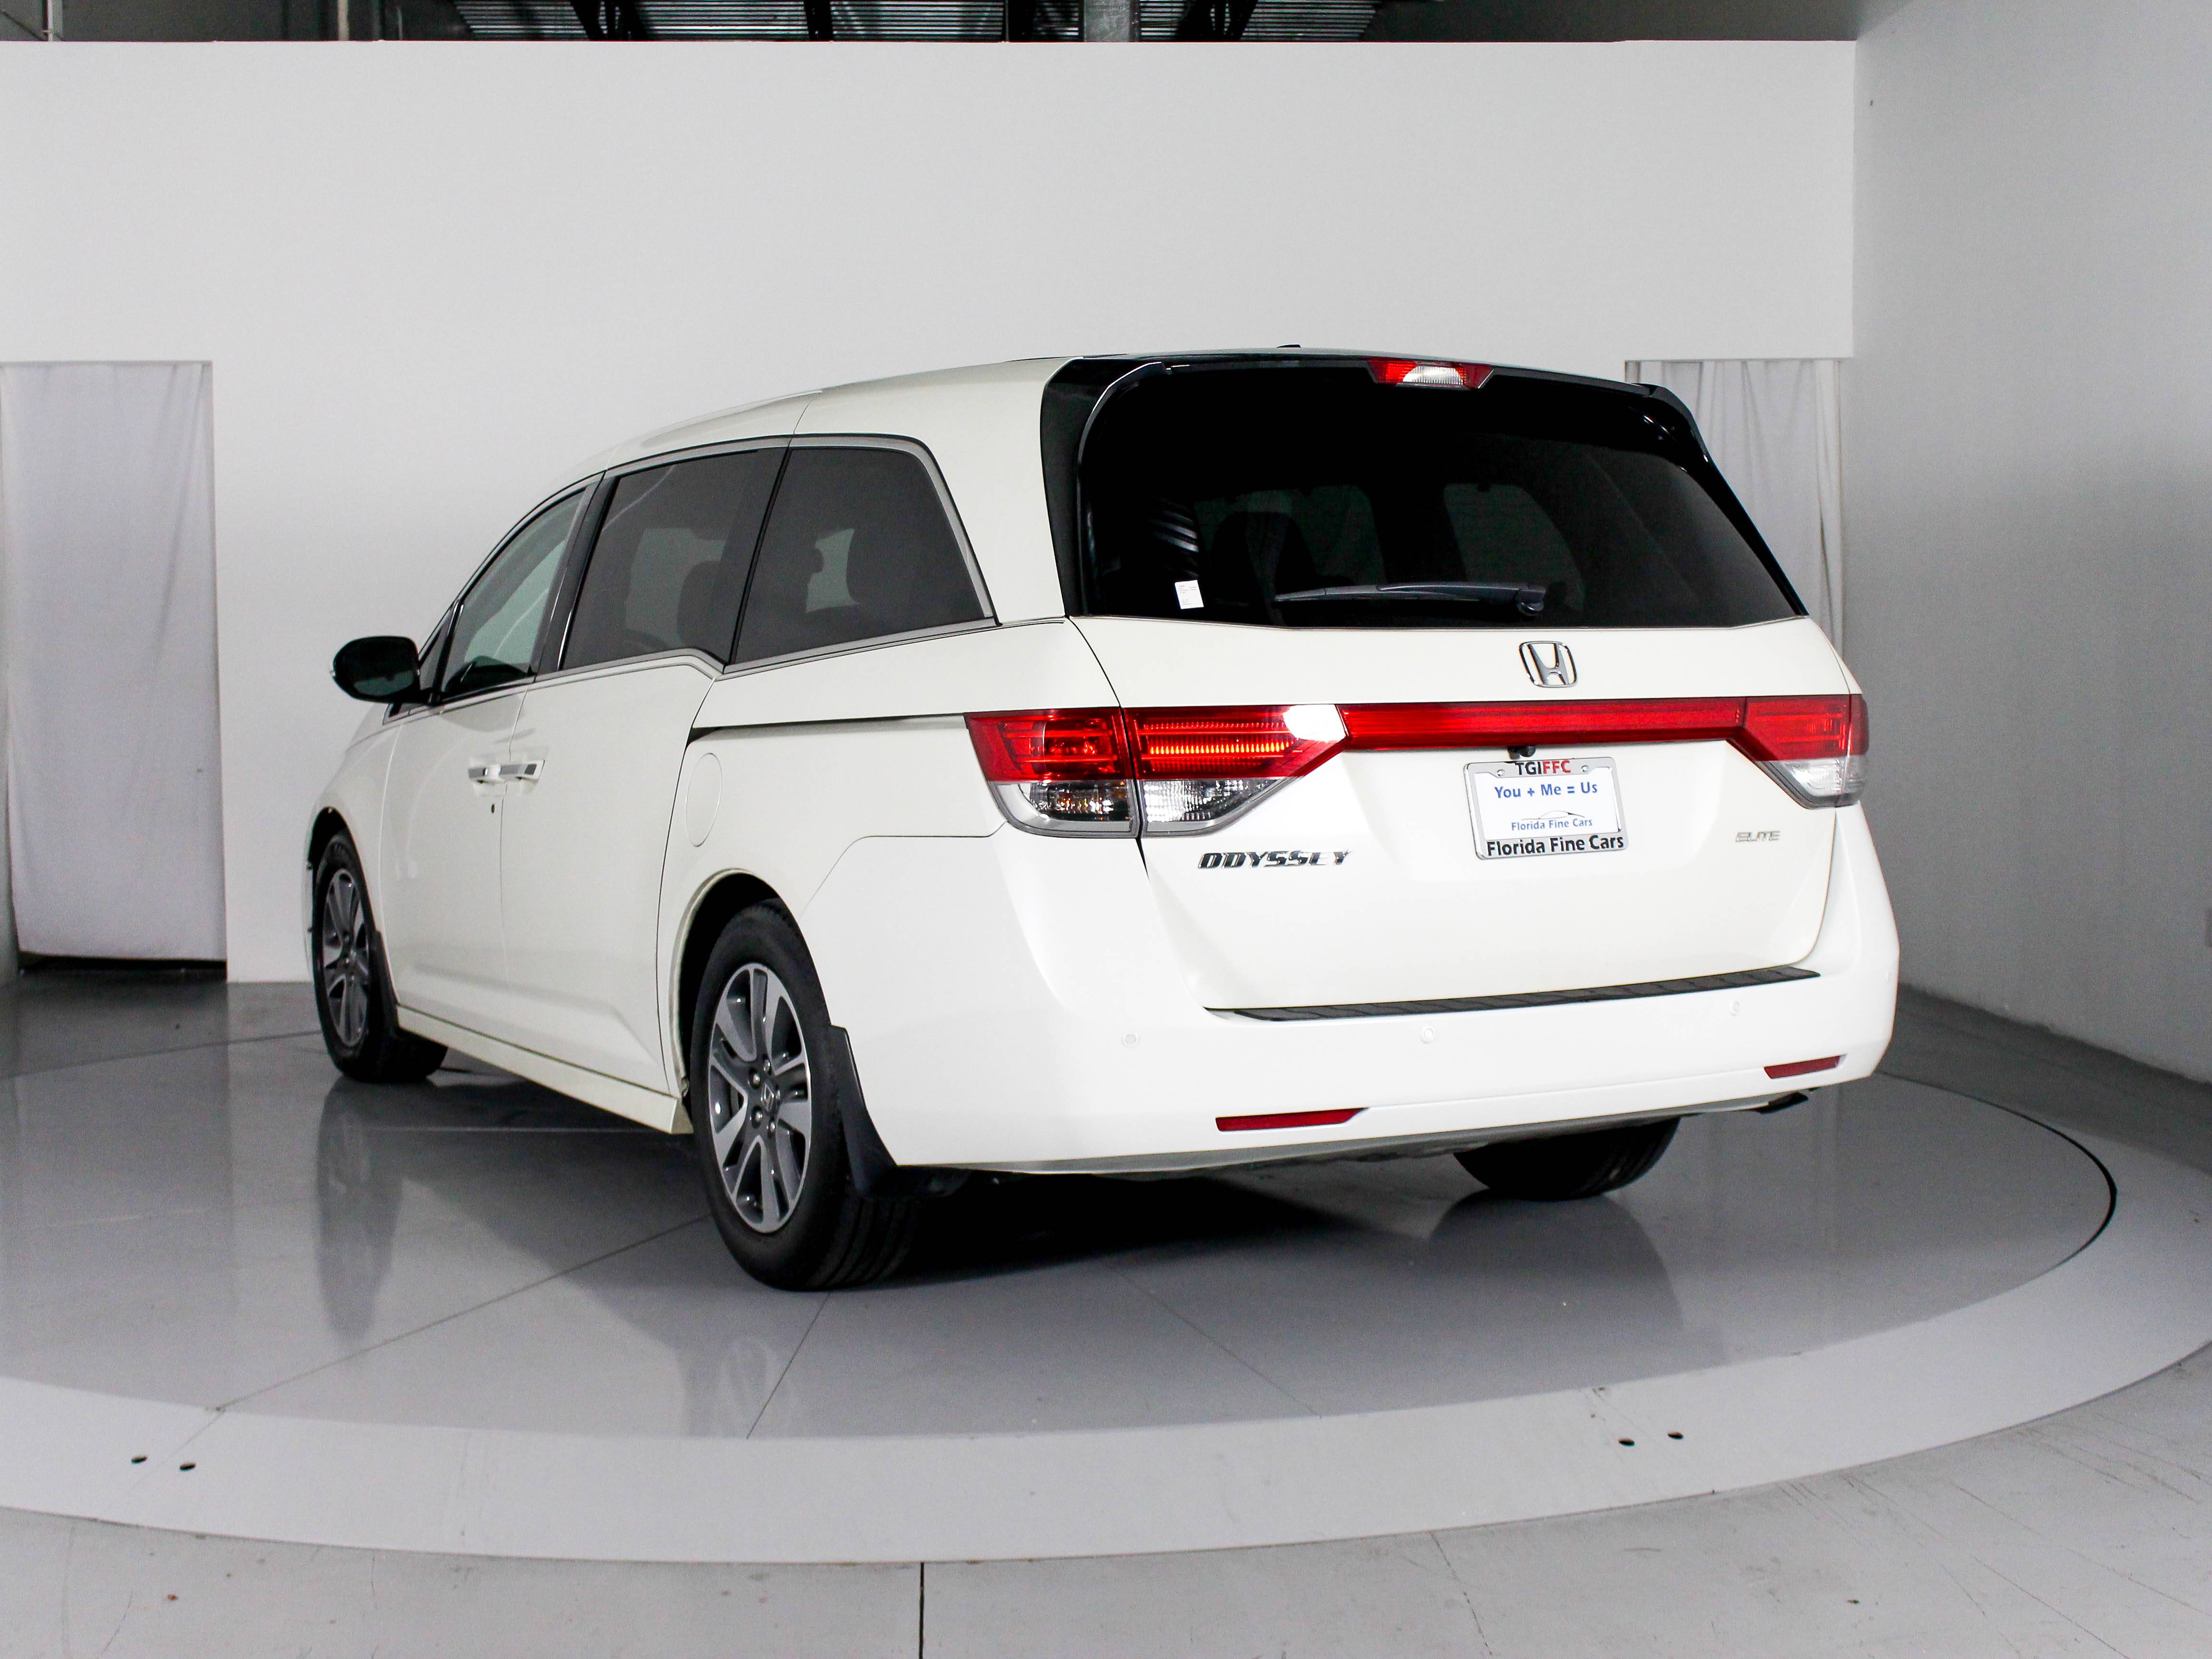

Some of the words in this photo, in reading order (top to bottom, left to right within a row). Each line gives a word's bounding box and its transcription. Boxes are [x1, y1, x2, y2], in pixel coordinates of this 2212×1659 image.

[1515, 760, 1571, 775] TGIFFC
[1494, 786, 1521, 798] You
[1541, 784, 1561, 795] Me
[1581, 782, 1598, 794] Us
[1512, 820, 1545, 830] Florida
[1549, 819, 1569, 828] Fine
[1573, 818, 1593, 827] Cars
[1487, 839, 1545, 856] Florida
[1550, 837, 1585, 852] Fine
[1589, 835, 1623, 850] Cars
[1198, 848, 1352, 869] ODYSSEY
